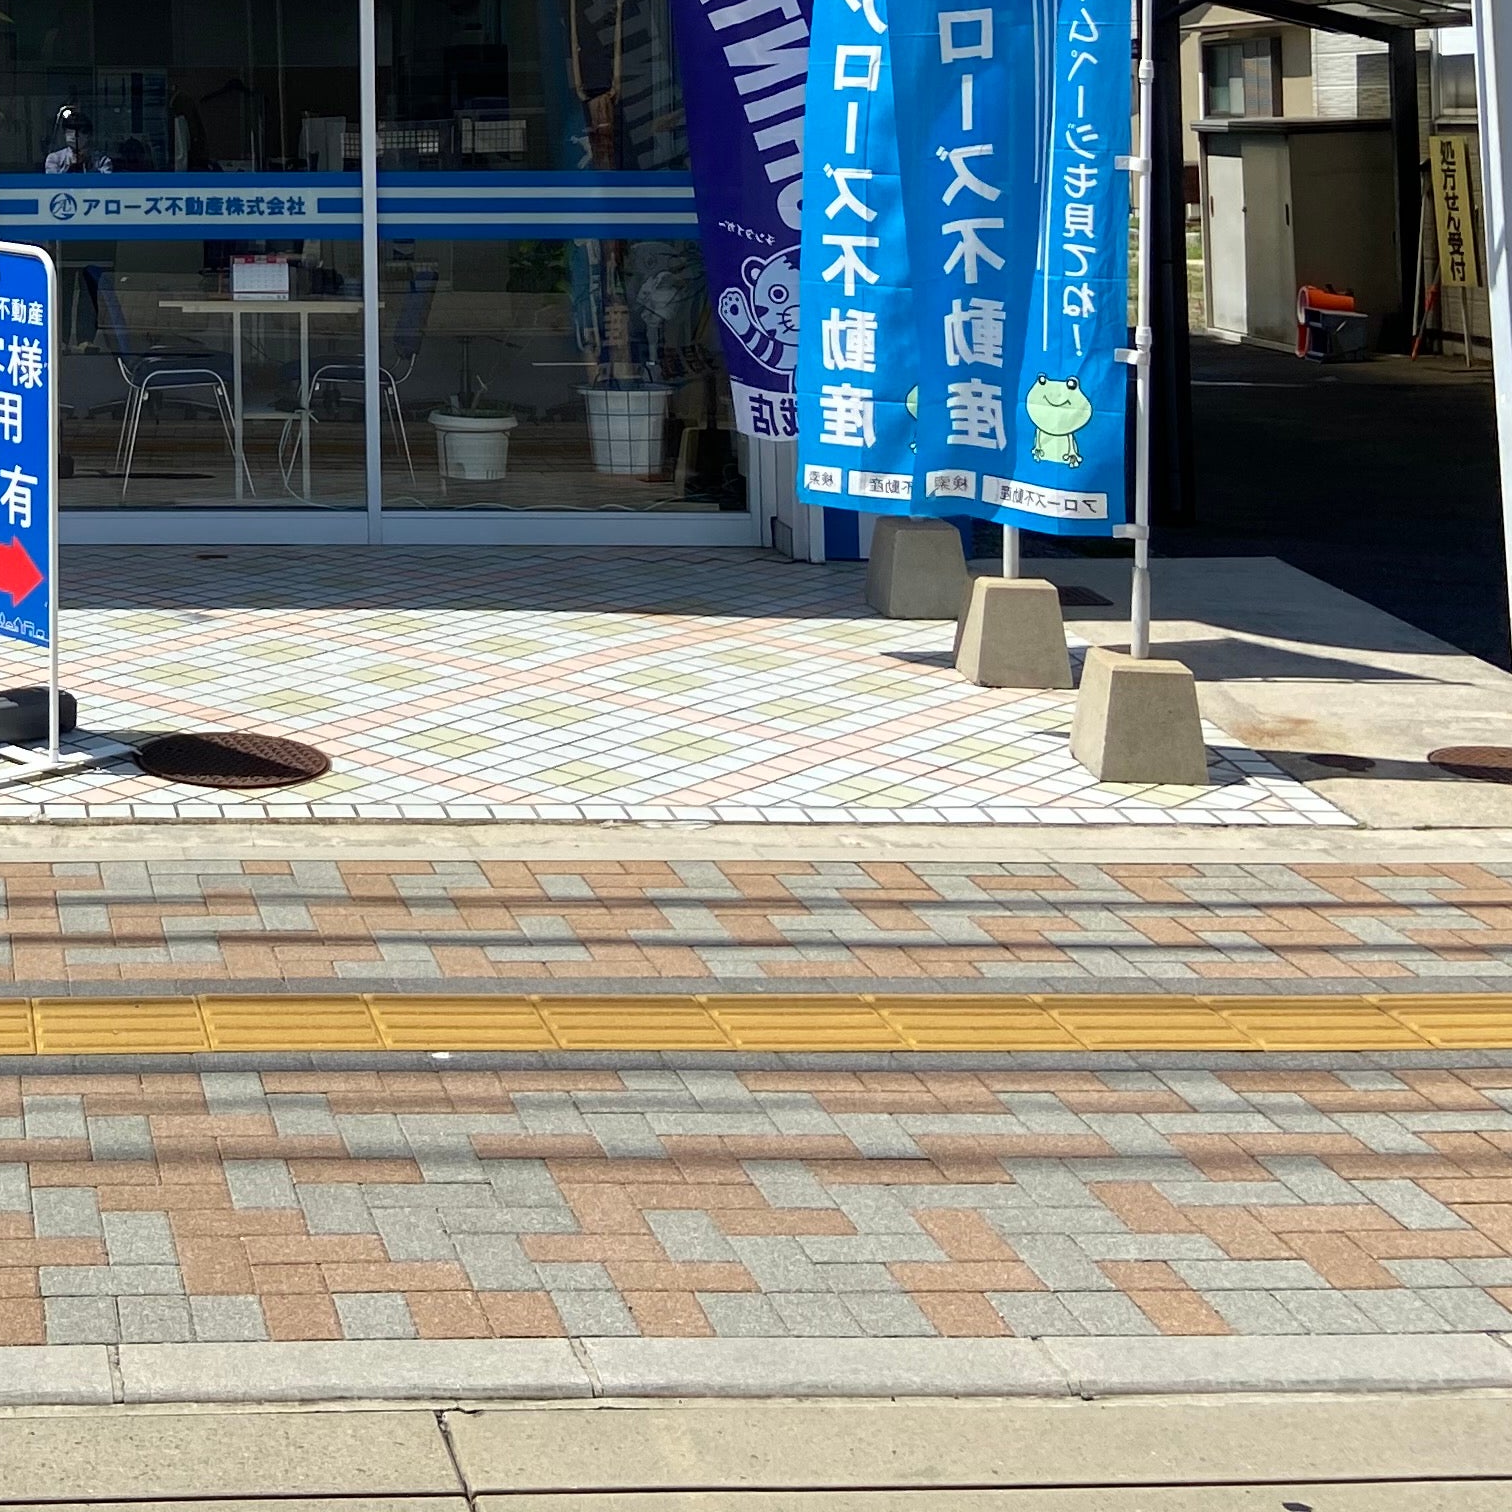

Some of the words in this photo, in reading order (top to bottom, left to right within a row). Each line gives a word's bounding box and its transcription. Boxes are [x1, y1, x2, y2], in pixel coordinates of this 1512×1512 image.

[82, 195, 306, 217] アローズ不動産株式会社
[1440, 139, 1466, 282] 処方せん受付
[0, 464, 38, 530] 有
